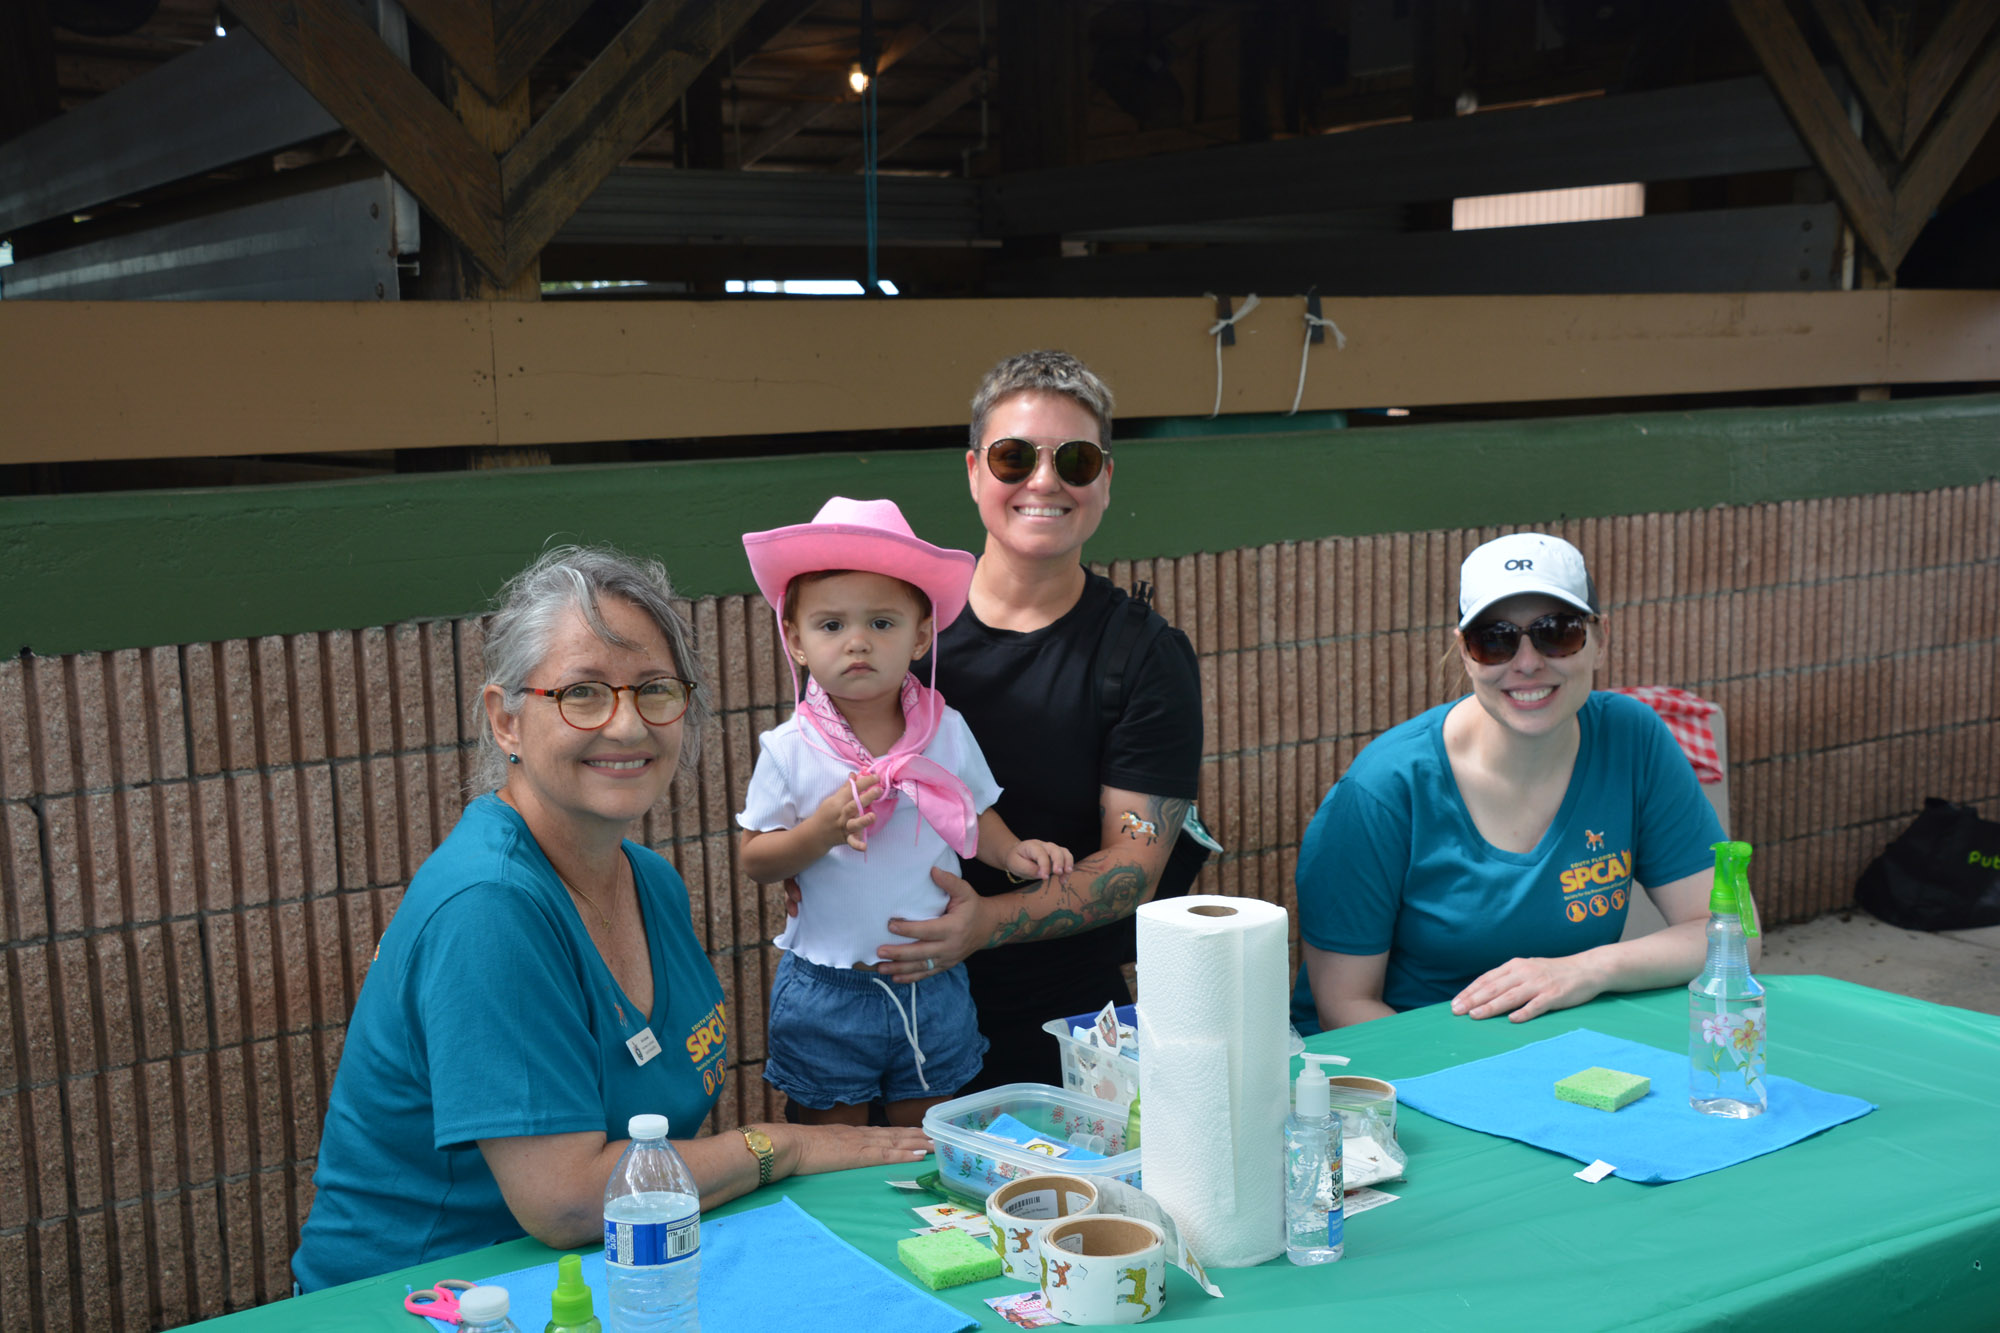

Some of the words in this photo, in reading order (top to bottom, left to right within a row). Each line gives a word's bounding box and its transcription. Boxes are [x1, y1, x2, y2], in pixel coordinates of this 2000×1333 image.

[1504, 559, 1534, 571] OR
[1570, 860, 1590, 868] SOUTH
[1591, 853, 1616, 862] FLORIDA
[1560, 857, 1626, 894] SPCA
